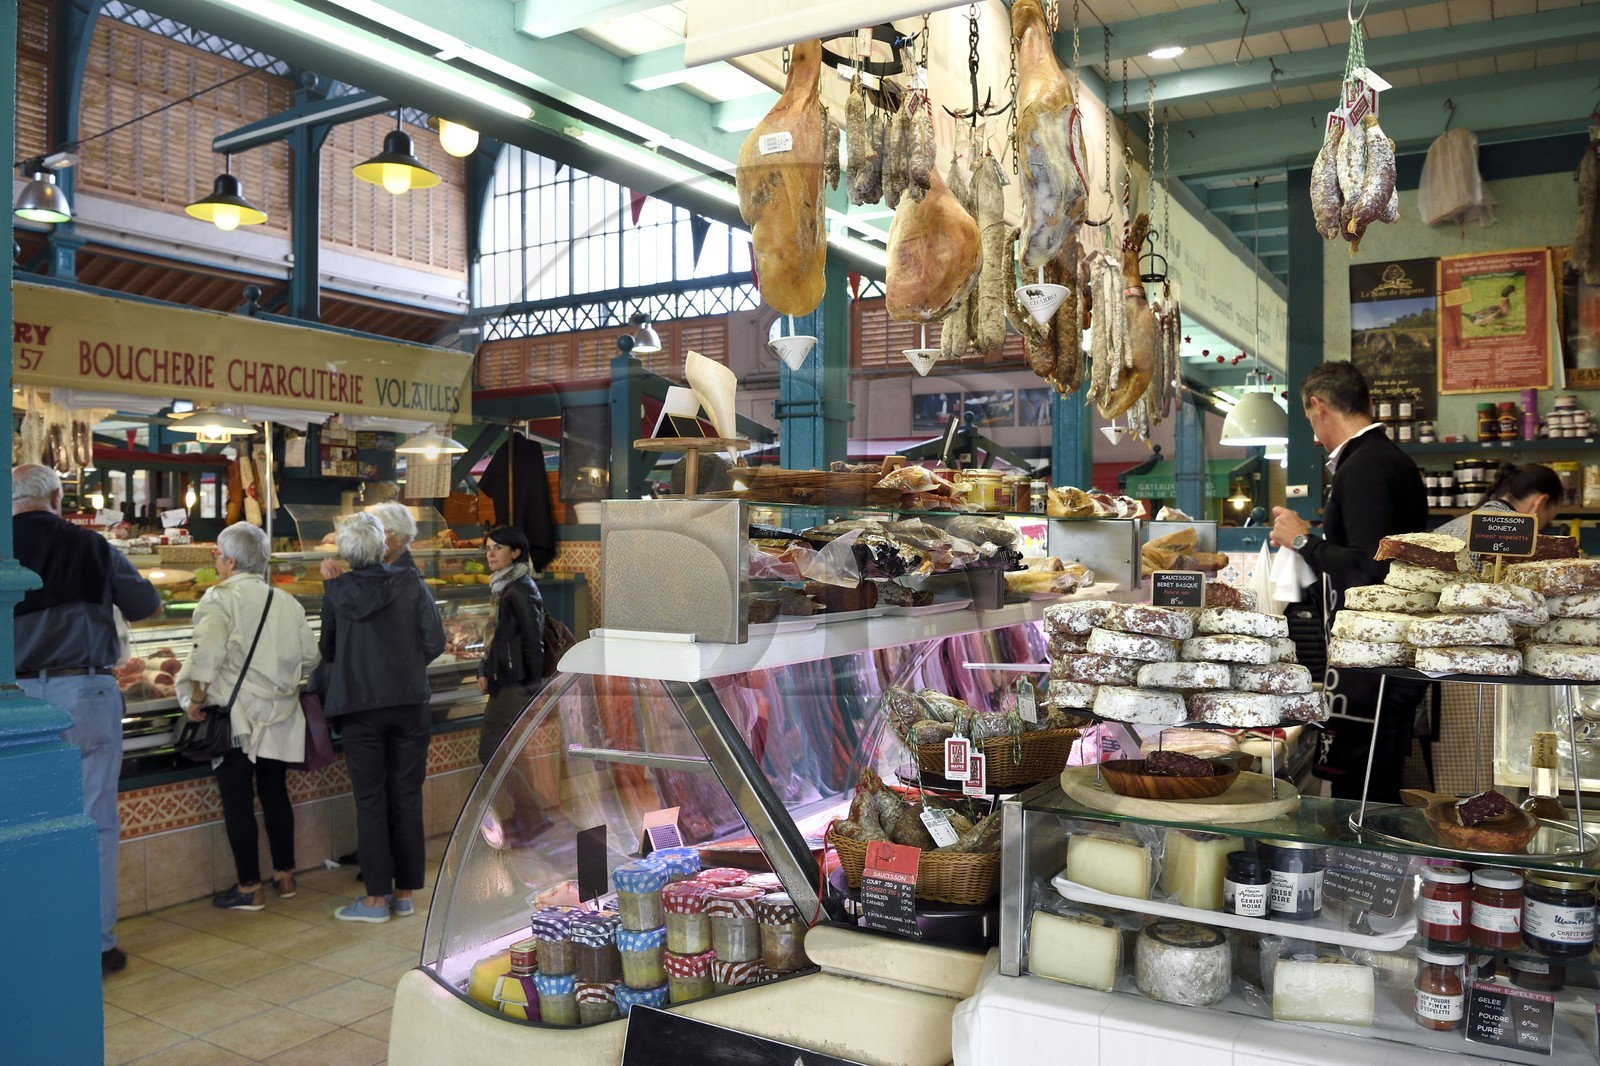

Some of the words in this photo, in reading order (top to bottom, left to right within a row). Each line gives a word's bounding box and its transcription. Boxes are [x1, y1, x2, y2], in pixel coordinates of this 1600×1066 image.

[1360, 290, 1371, 298] Le
[1371, 288, 1388, 297] Noir
[1388, 288, 1398, 296] de
[1399, 287, 1425, 296] Bigorre
[1030, 294, 1057, 306] CHARRO
[19, 348, 44, 370] 57
[1326, 869, 1340, 877] Cerise
[1344, 864, 1368, 874] CONFITURE
[873, 871, 907, 882] SAUCISSON
[1271, 888, 1292, 897] ERISE
[866, 899, 885, 907] CANARD
[1475, 983, 1501, 992] Piment
[1504, 989, 1551, 1002] ESPELETTE
[1431, 996, 1451, 1004] POUDRE
[1478, 997, 1502, 1006] GELEE
[1420, 1005, 1450, 1015] D'ESPELETTE
[1479, 1012, 1510, 1023] POUDRE
[1477, 1025, 1504, 1035] PUREE
